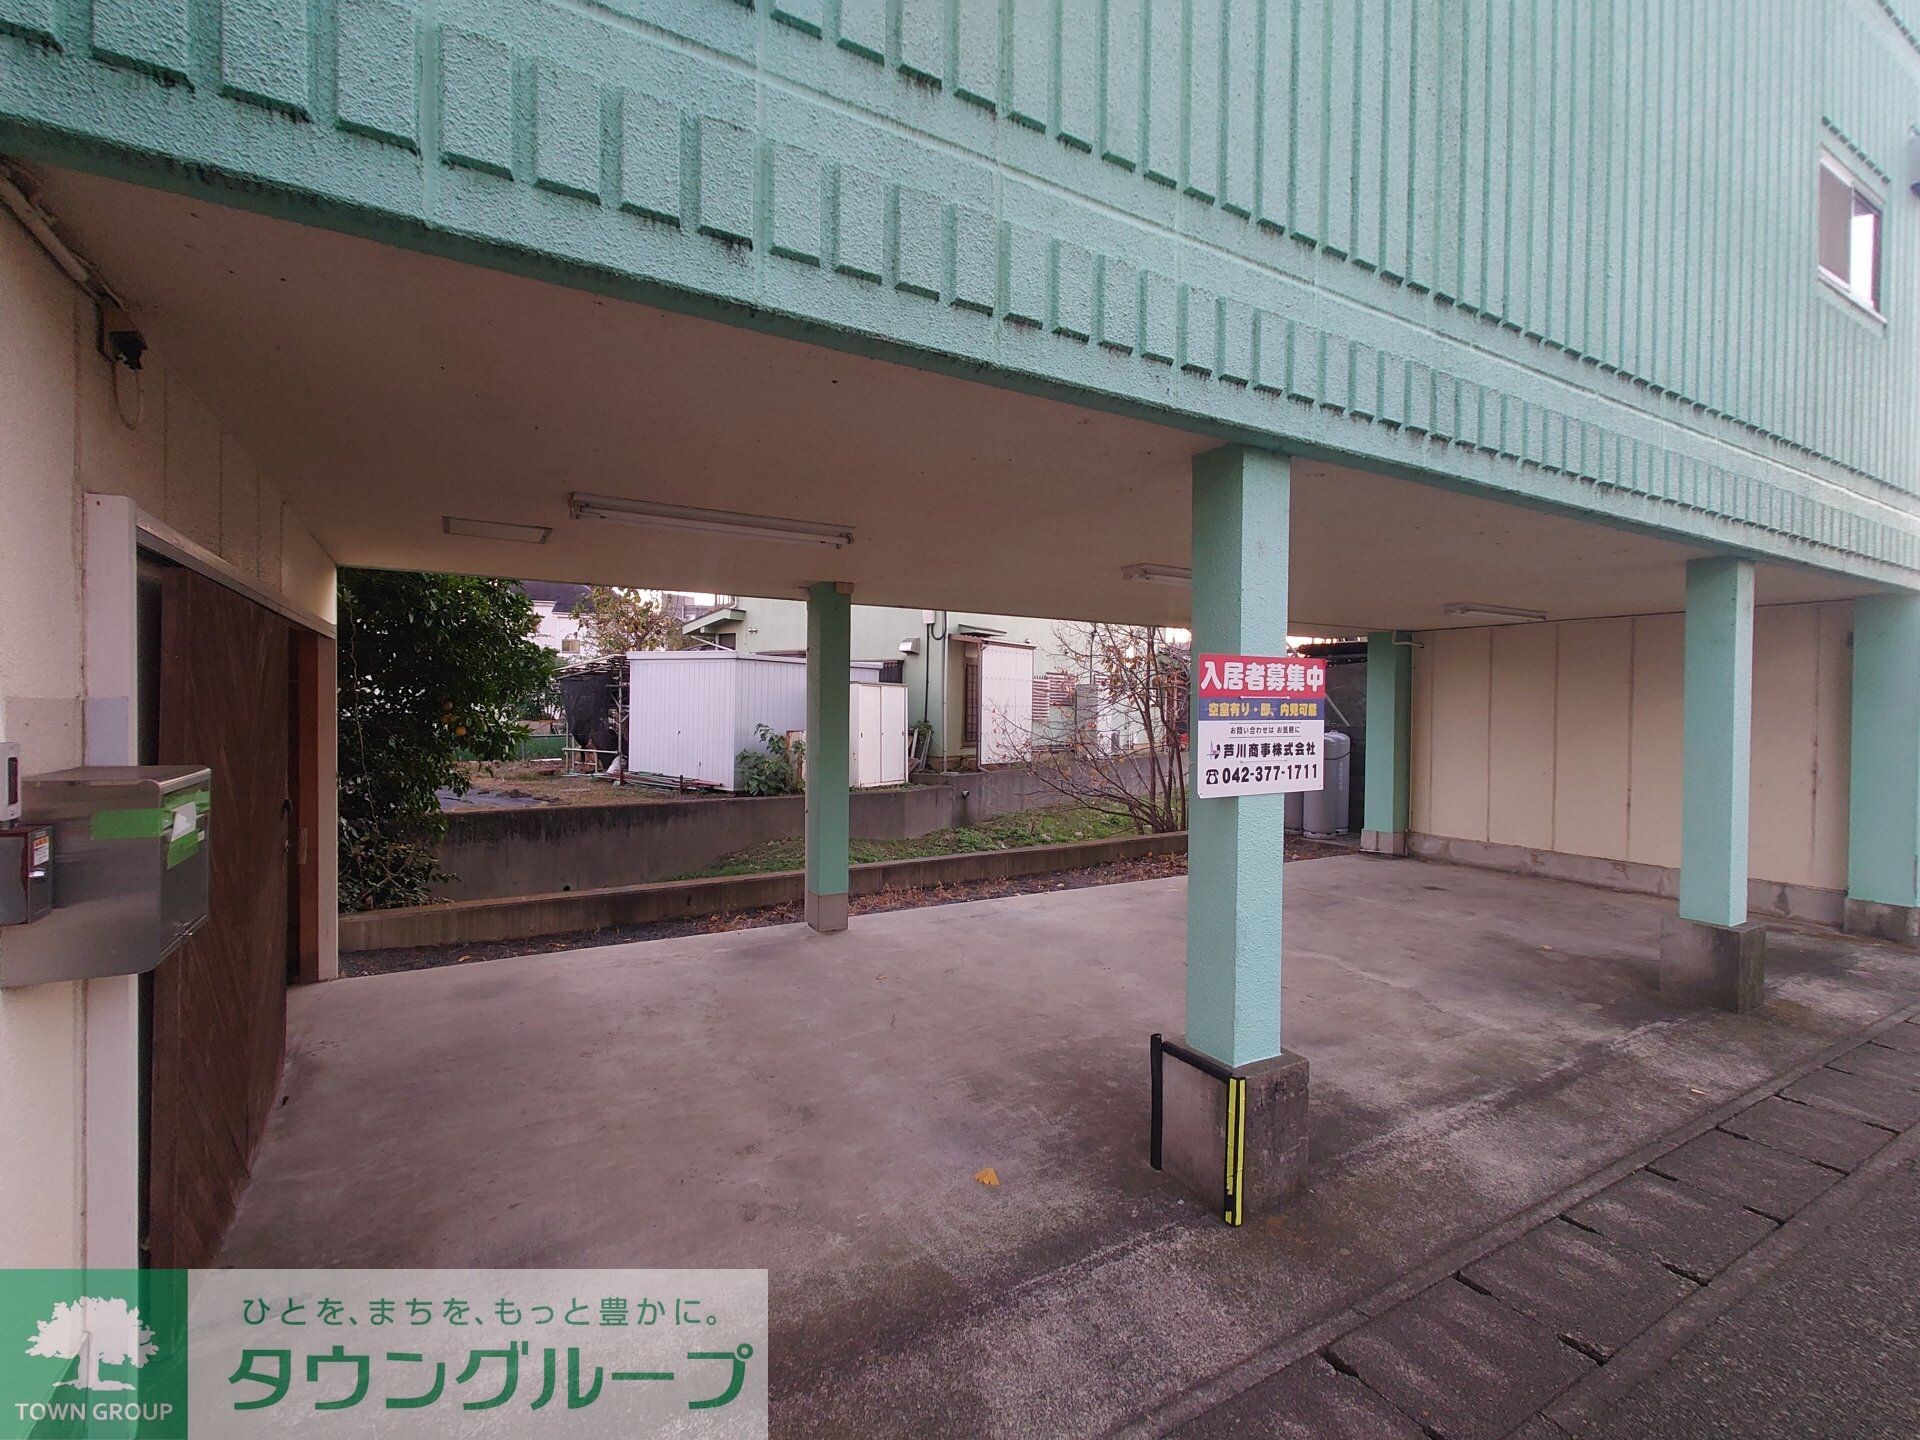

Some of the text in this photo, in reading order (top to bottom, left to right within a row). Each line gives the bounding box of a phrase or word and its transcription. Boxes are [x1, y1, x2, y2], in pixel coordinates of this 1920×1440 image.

[1200, 660, 1324, 692] 入居者募集中
[1223, 741, 1316, 759] 芦川商事株式会社
[1222, 763, 1318, 784] 042-377-1711
